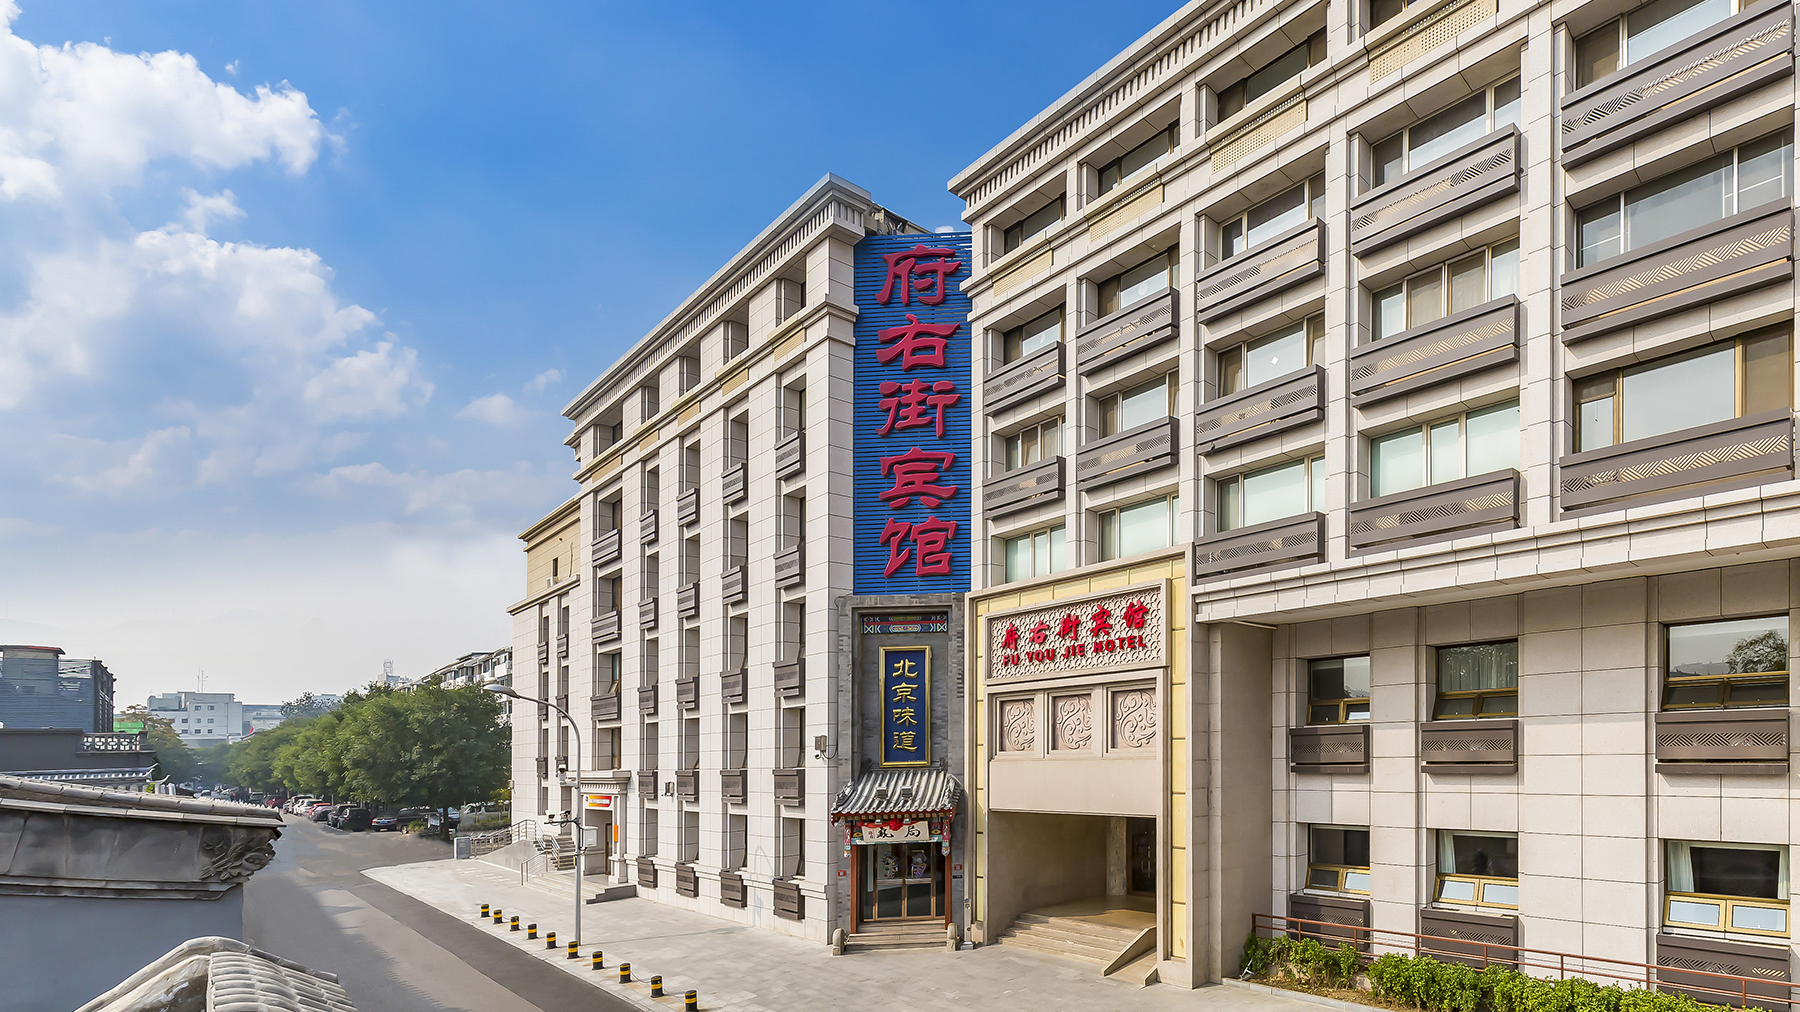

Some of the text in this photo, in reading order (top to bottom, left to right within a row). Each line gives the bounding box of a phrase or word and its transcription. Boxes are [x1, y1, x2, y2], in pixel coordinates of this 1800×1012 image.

[876, 245, 961, 578] 府右街宾馆
[1000, 599, 1148, 650] 府右街宾馆
[1002, 634, 1146, 666] FU YOU JIE HOTEL
[891, 658, 919, 753] 北京味道
